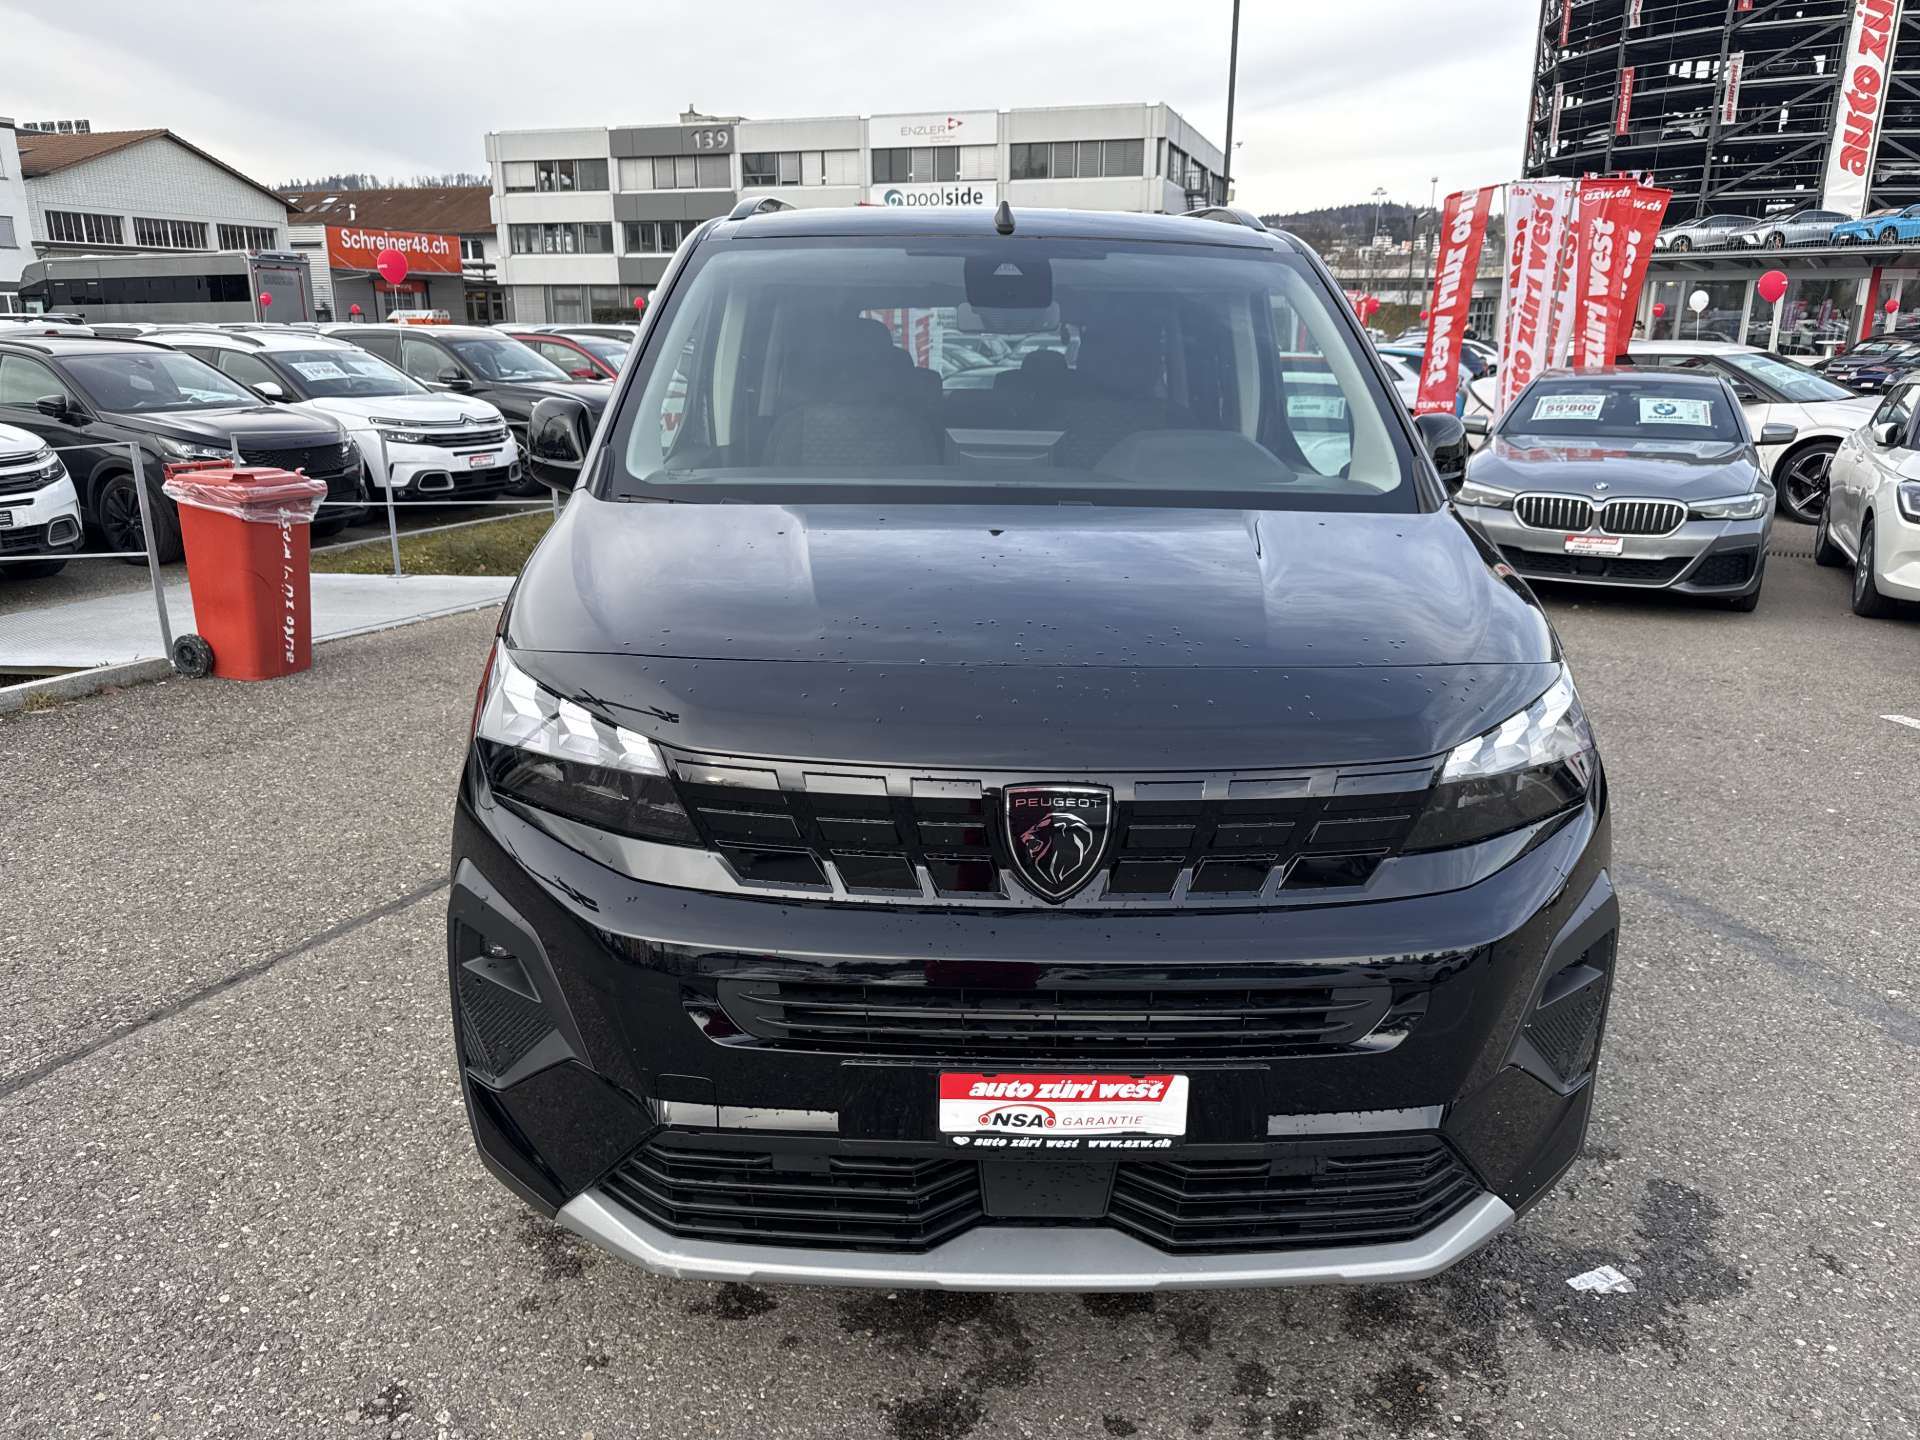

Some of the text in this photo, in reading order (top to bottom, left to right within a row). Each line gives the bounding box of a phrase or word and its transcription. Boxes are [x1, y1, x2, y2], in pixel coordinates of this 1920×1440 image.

[1840, 65, 1881, 176] auto
[689, 130, 729, 149] 139
[900, 125, 946, 136] ENZLER
[906, 187, 984, 206] poolside
[1583, 186, 1631, 201] azw.ch
[1529, 191, 1555, 270] west
[341, 228, 450, 254] Schreiner48.ch
[1584, 217, 1615, 367] züri west
[1518, 274, 1542, 350] züri
[1015, 797, 1102, 808] PEUGEOT
[968, 1080, 1165, 1098] auto züri west
[992, 1112, 1144, 1128] NSA GARANTIE
[973, 1137, 1173, 1148] auto züri west www.azw.ch
